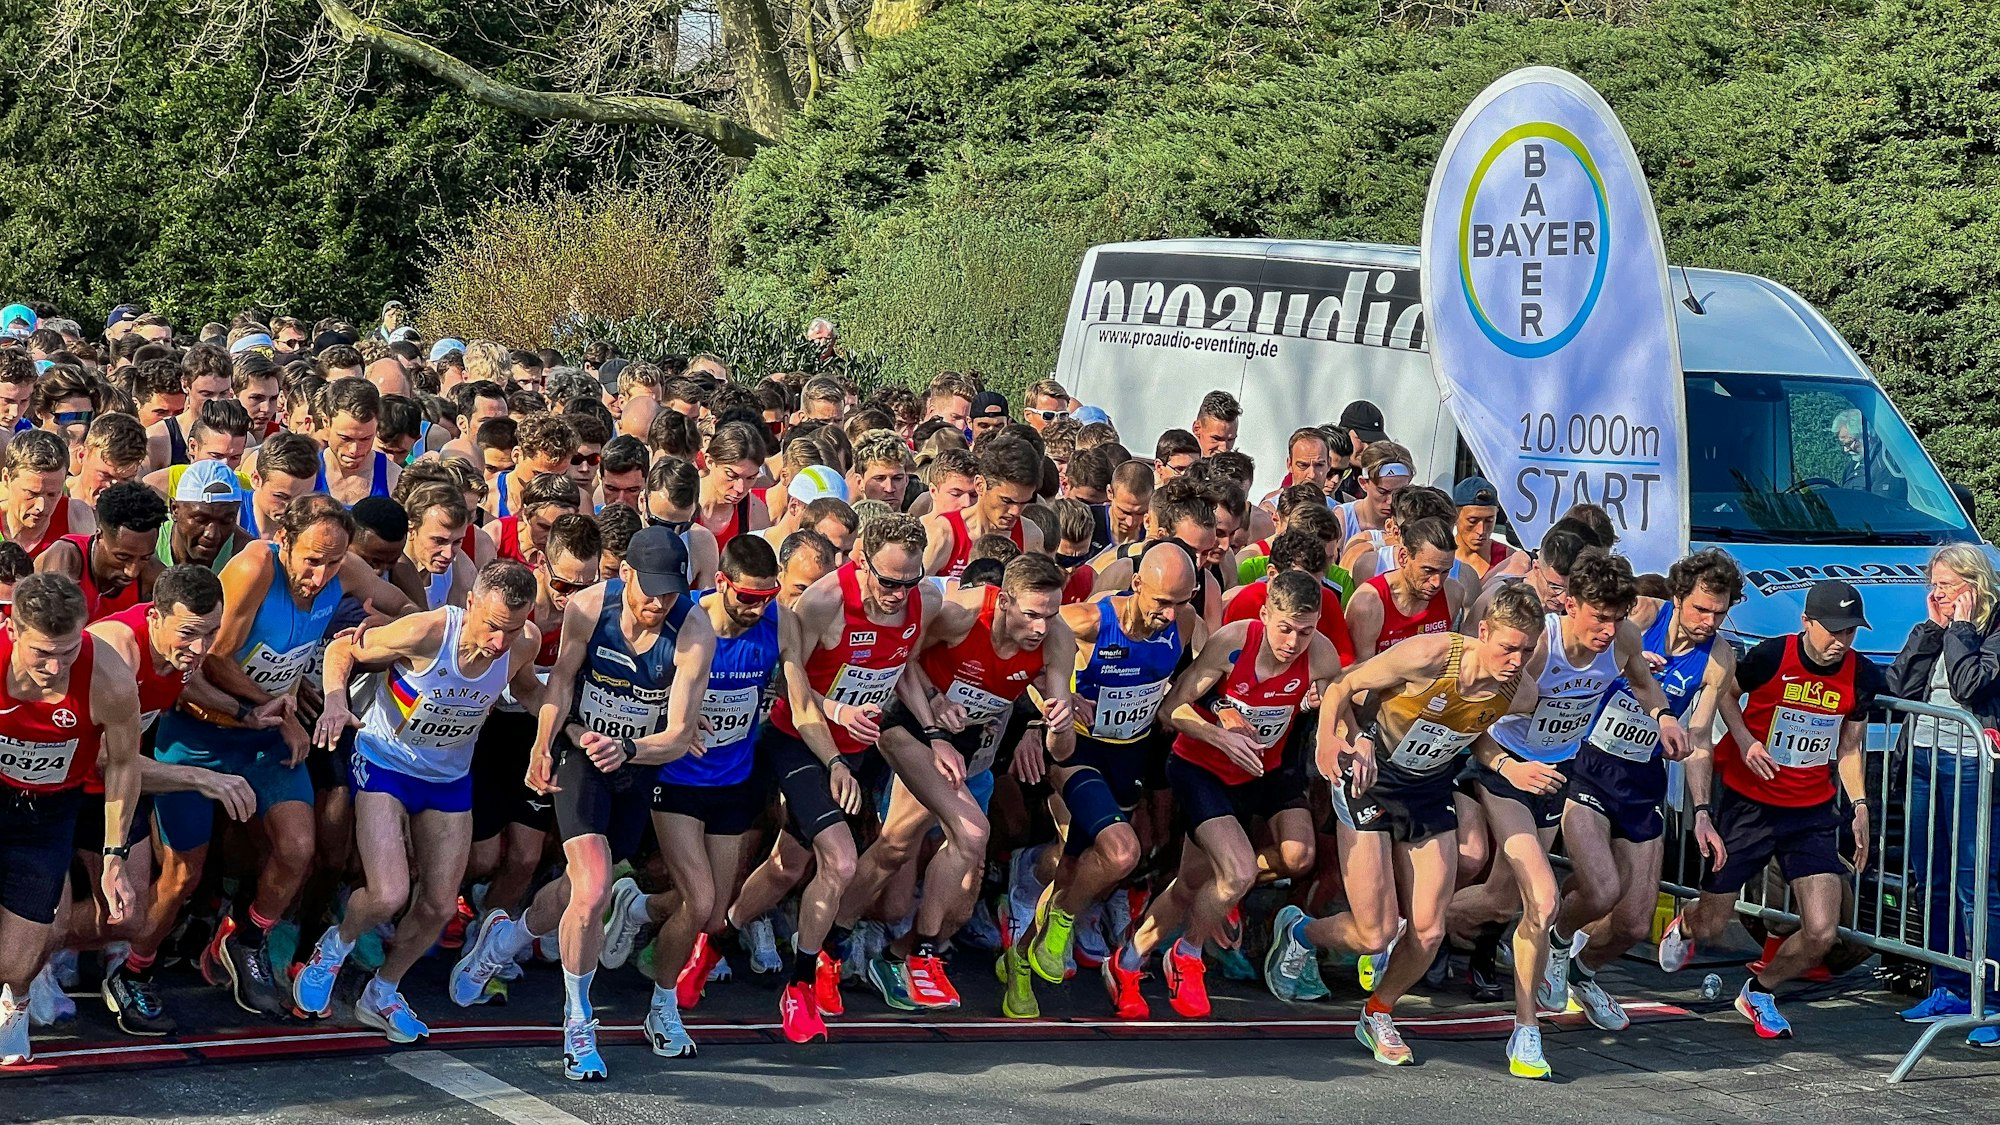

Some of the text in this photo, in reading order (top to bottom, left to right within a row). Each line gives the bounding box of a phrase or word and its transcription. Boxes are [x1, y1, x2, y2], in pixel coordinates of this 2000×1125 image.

[1473, 221, 1596, 258] BAYER
[1519, 144, 1547, 337] BAYER
[1098, 329, 1279, 358] www.proaudio-eventing.de
[1519, 412, 1660, 457] 10.000m
[1515, 466, 1661, 531] START
[1424, 620, 1447, 632] BIGGE
[851, 633, 874, 641] NTA
[729, 671, 764, 679] FINANZ
[847, 669, 874, 681] GLS
[957, 687, 985, 700] GLS
[1107, 691, 1133, 700] GLS
[1551, 679, 1602, 695] HANAU
[432, 688, 490, 704] HANAU
[590, 691, 614, 709] GLS
[423, 703, 451, 716] GLS
[1101, 700, 1161, 726] 10457
[1546, 700, 1572, 710] GLS
[584, 711, 648, 738] 10801
[1537, 713, 1592, 734] 10939
[1781, 711, 1806, 723] GLS
[409, 718, 477, 738] 10954
[1421, 724, 1446, 737] GLS
[1604, 716, 1659, 747] 10800
[1774, 731, 1831, 753] 11063
[1356, 805, 1377, 822] LSC
